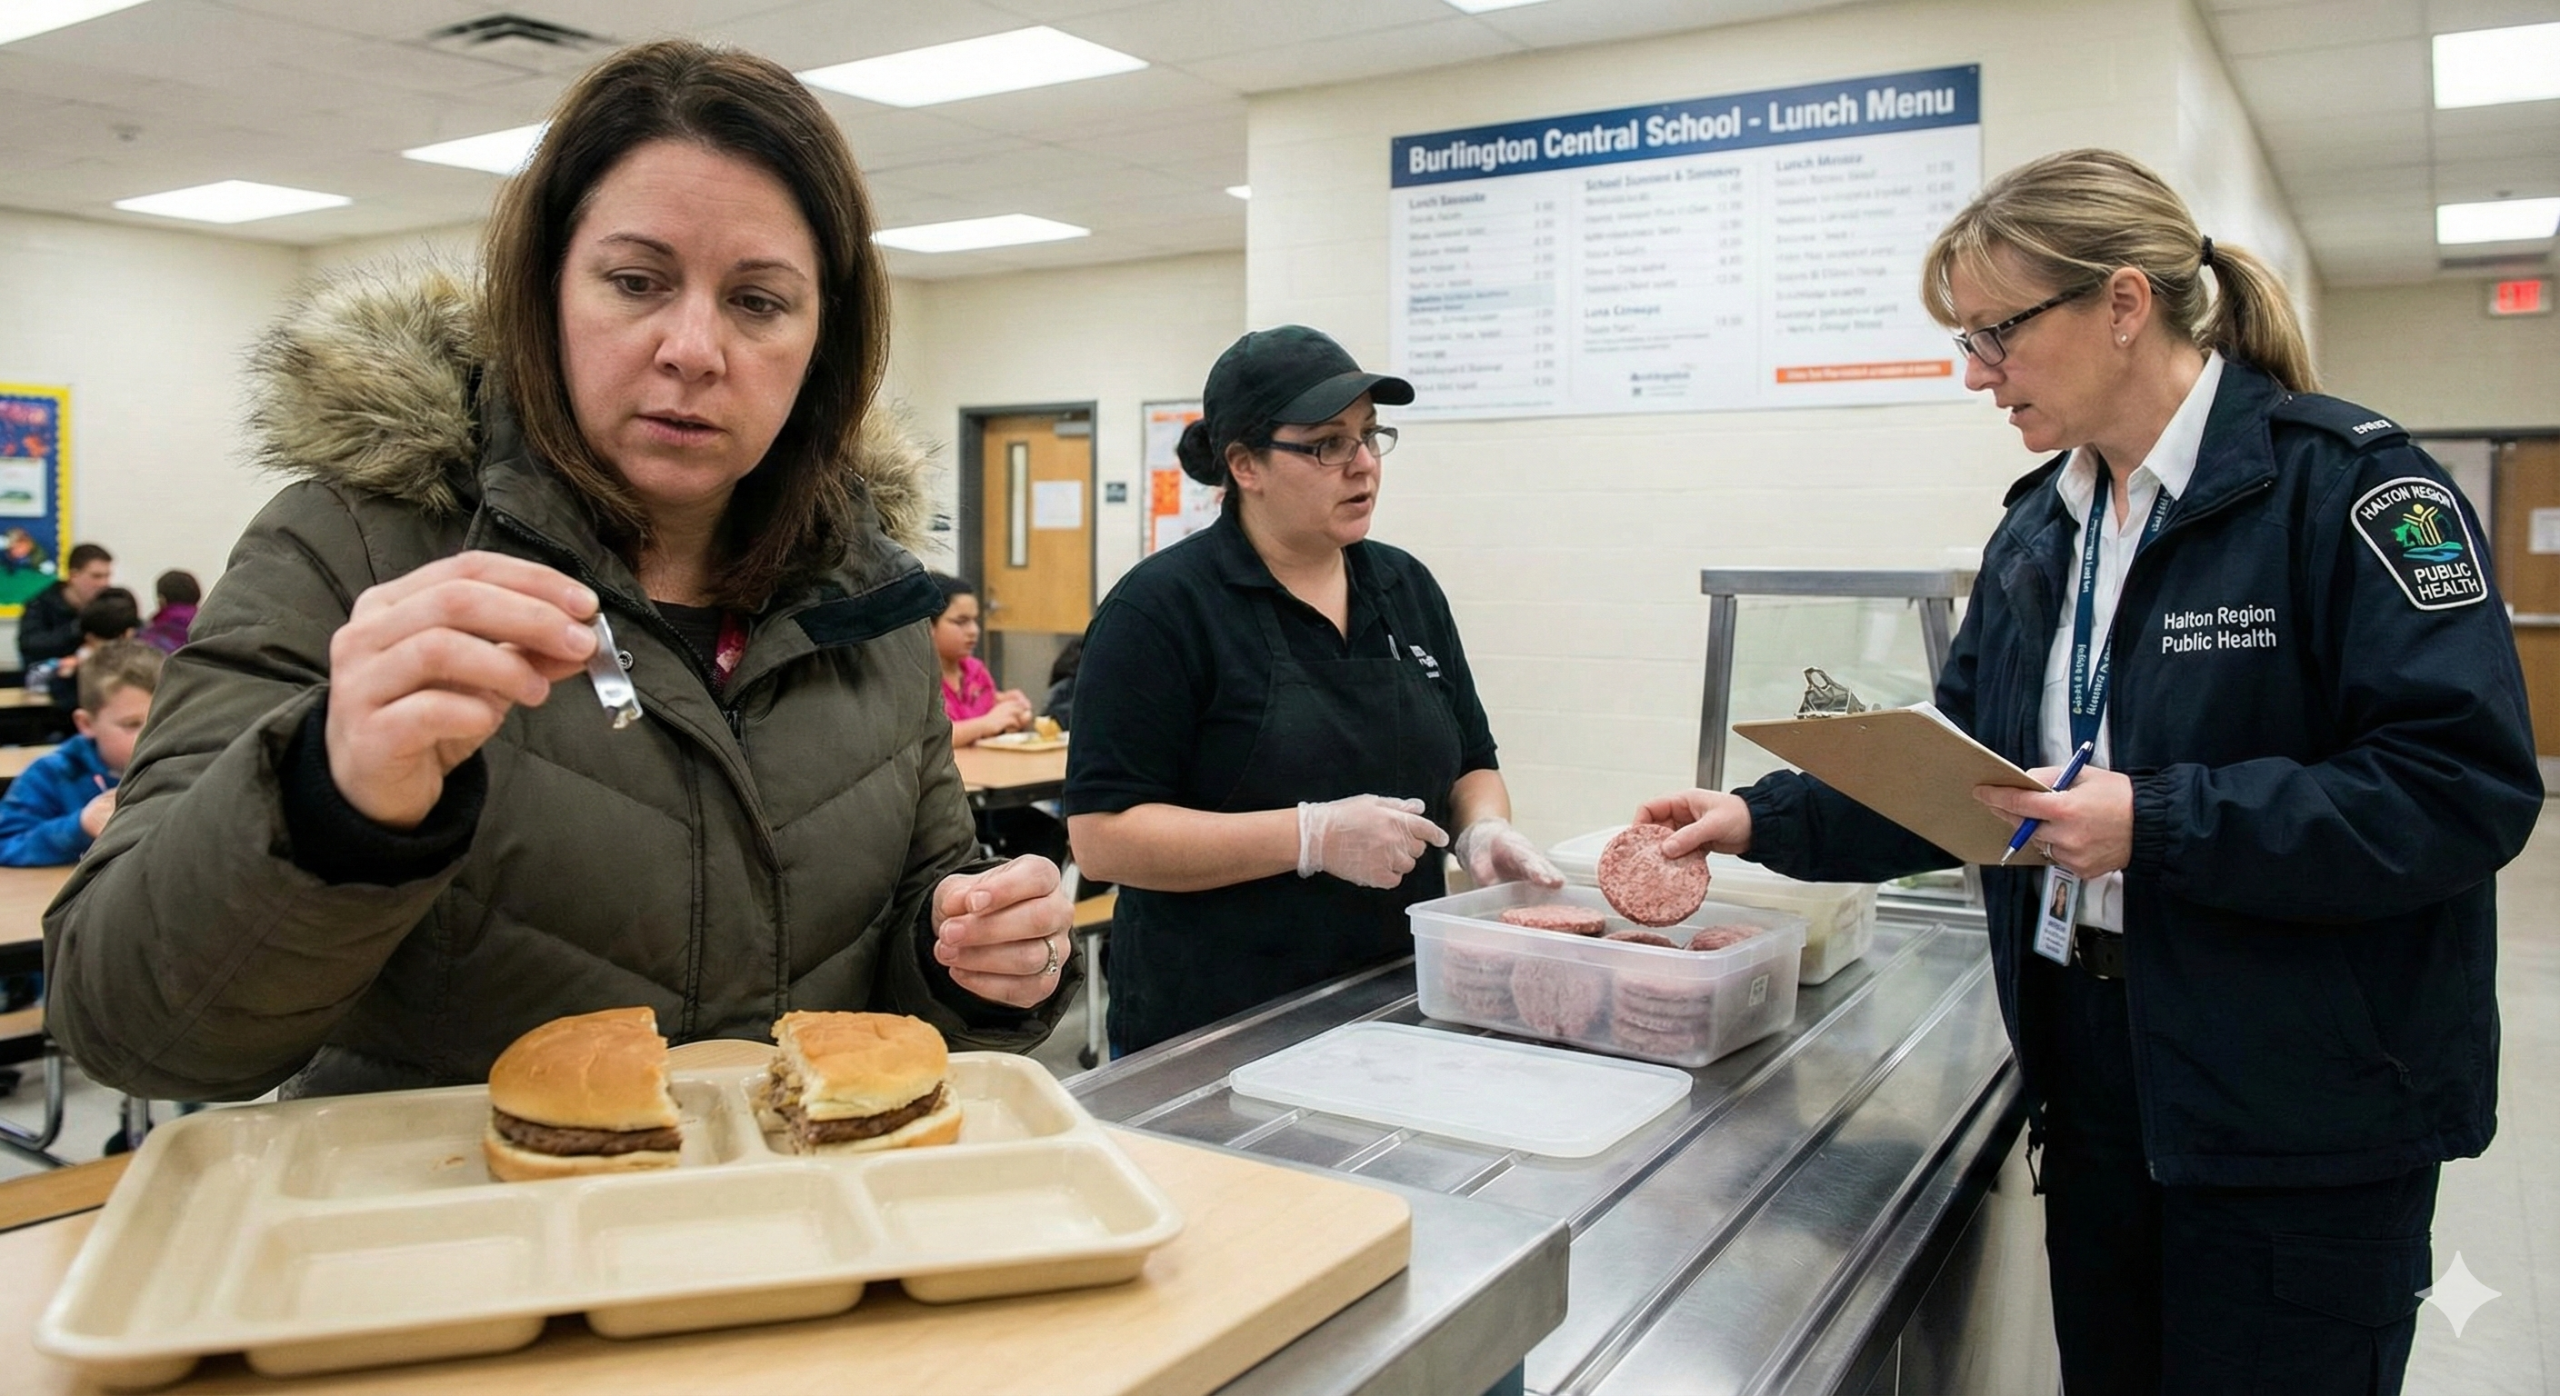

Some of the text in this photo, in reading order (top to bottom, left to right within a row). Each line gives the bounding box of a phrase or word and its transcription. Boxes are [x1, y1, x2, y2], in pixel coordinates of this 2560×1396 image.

[1408, 86, 1956, 175] Burlington Central School - Lunch Menu
[2360, 486, 2411, 520] HALTON
[2414, 562, 2472, 584] PUBLIC
[2417, 578, 2480, 601] HEALTH
[2164, 604, 2276, 630] Halton Region
[2162, 628, 2277, 654] Public Health
